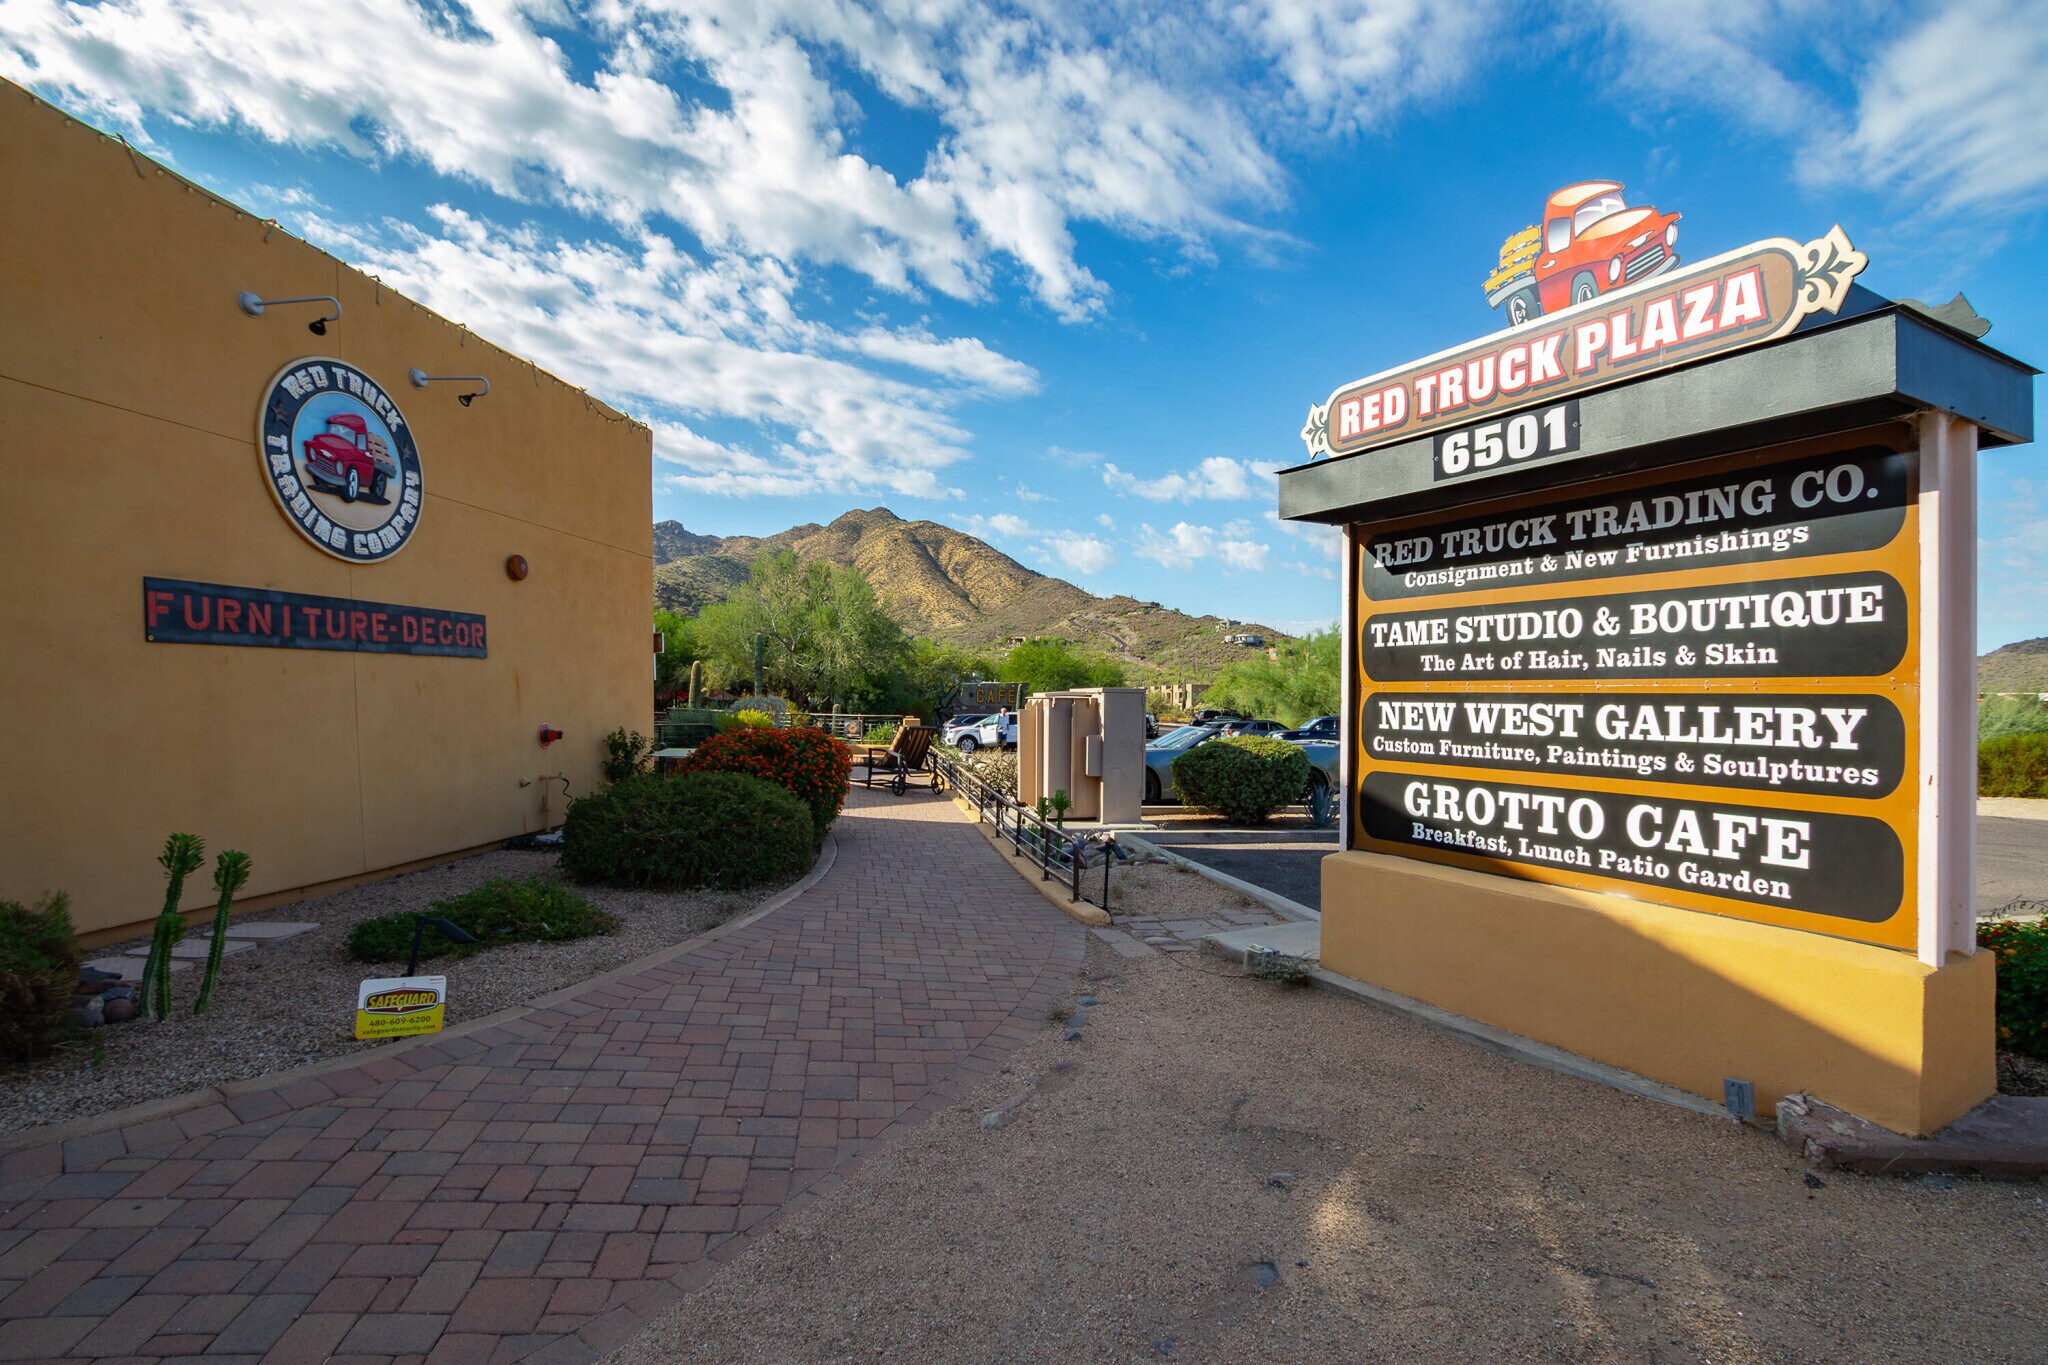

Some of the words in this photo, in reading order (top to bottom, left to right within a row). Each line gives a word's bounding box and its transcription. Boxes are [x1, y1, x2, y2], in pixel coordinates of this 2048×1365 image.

[1338, 384, 1408, 441] RED
[1414, 330, 1566, 419] TRUCK
[1574, 265, 1768, 374] PLAZA
[281, 365, 329, 399] RED
[331, 366, 404, 433] TRUCK
[1442, 405, 1567, 474] 6501
[267, 434, 347, 551] TRADING
[353, 470, 420, 556] COMPANY
[1373, 536, 1433, 568] RED
[1441, 515, 1557, 559] TRUCK
[1567, 479, 1776, 540] TRADING
[1791, 464, 1879, 508] CO.
[1404, 559, 1533, 588] Consignment
[1540, 554, 1558, 572] &
[1565, 550, 1617, 569] New
[1626, 525, 1809, 563] Furnishings
[1371, 618, 1448, 647] TAME
[1455, 608, 1583, 643] STUDIO
[1592, 606, 1620, 636] &
[1630, 585, 1883, 635] BOUTIQUE
[1421, 654, 1455, 671] The
[1460, 653, 1494, 670] Art
[1500, 652, 1524, 670] of
[1528, 651, 1588, 670] Hair,
[1596, 646, 1666, 668] Nails
[1675, 645, 1696, 665] &
[1705, 642, 1778, 665] Skin
[975, 690, 1016, 703] CAFE
[1378, 701, 1456, 732] NEW
[1464, 703, 1584, 738] WEST
[1595, 704, 1867, 750] GALLERY
[1373, 736, 1435, 755] Custom
[1439, 739, 1540, 764] Furniture,
[1547, 745, 1666, 775] Paintings
[1674, 752, 1695, 772] &
[1703, 753, 1879, 785] Sculptures
[1404, 781, 1604, 840] GROTTO
[1626, 804, 1810, 869] CAFE
[1412, 822, 1512, 856] Breakfast,
[1518, 838, 1591, 867] Lunch
[1599, 849, 1669, 878] Patio
[1677, 862, 1792, 900] Garden
[362, 1024, 436, 1035] safeguardsecurity.com
[368, 992, 436, 1008] SAFEGUARD
[369, 1016, 431, 1027] 480-609-6200
